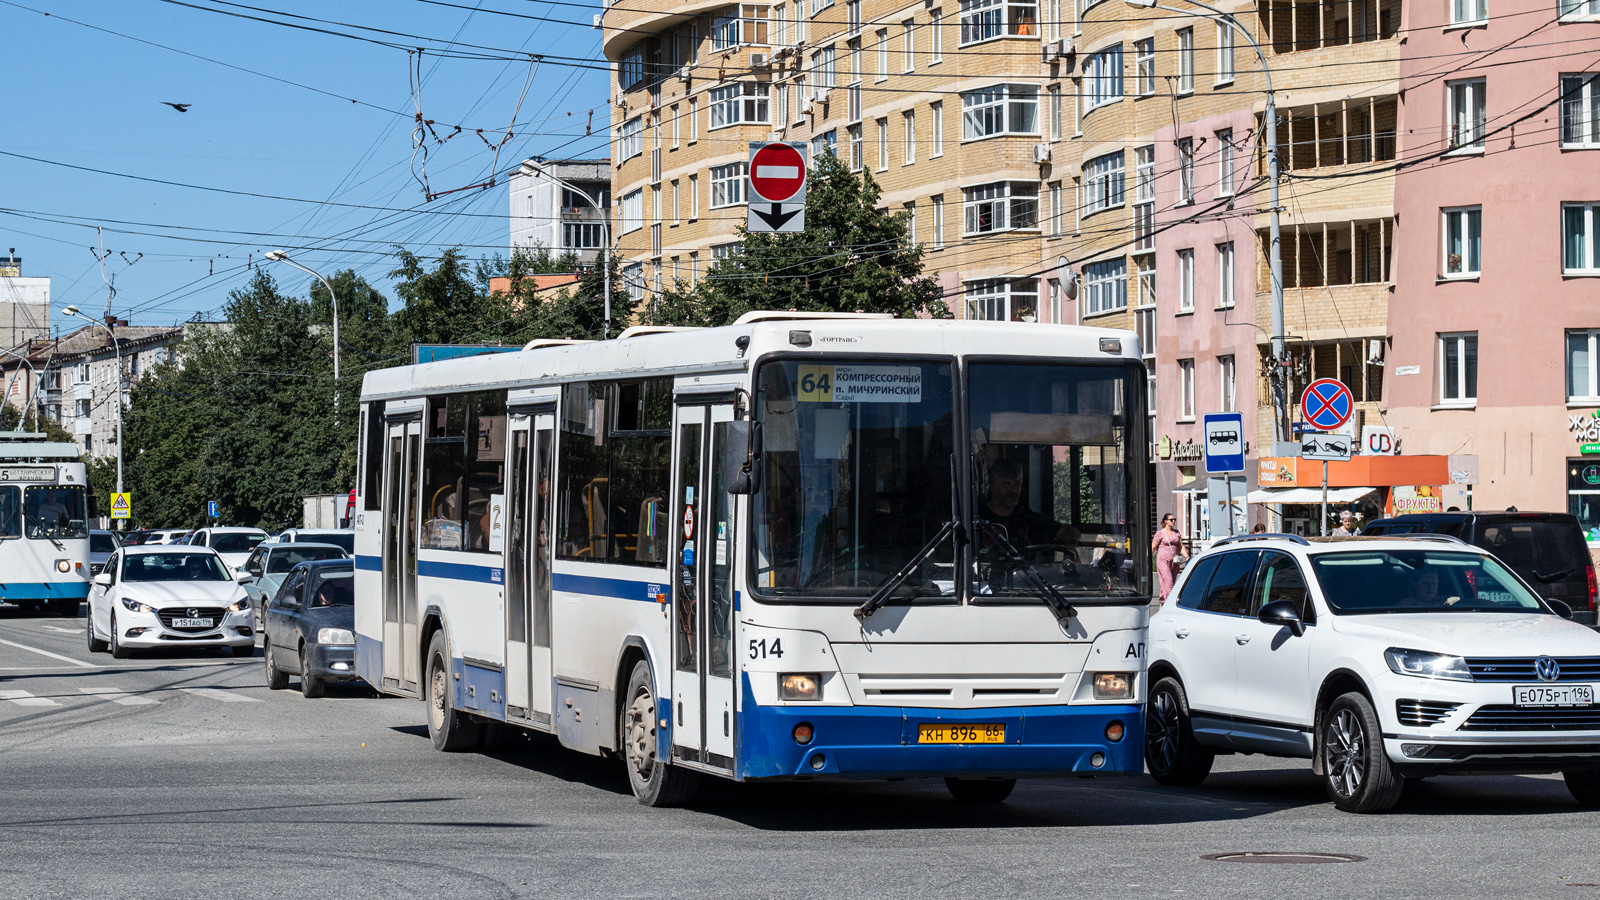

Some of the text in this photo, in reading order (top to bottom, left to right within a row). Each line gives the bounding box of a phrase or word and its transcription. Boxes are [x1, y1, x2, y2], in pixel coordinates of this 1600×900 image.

[801, 373, 831, 394] 64
[836, 373, 921, 384] КОМПРЕССОРНЫЙ
[848, 385, 920, 395] МИЧУРИНСКИЙ
[1397, 498, 1438, 510] ФРУКТЫ
[749, 637, 784, 660] 514
[1520, 687, 1590, 703] Е075РТ 196
[926, 725, 1000, 741] КН 896 66
